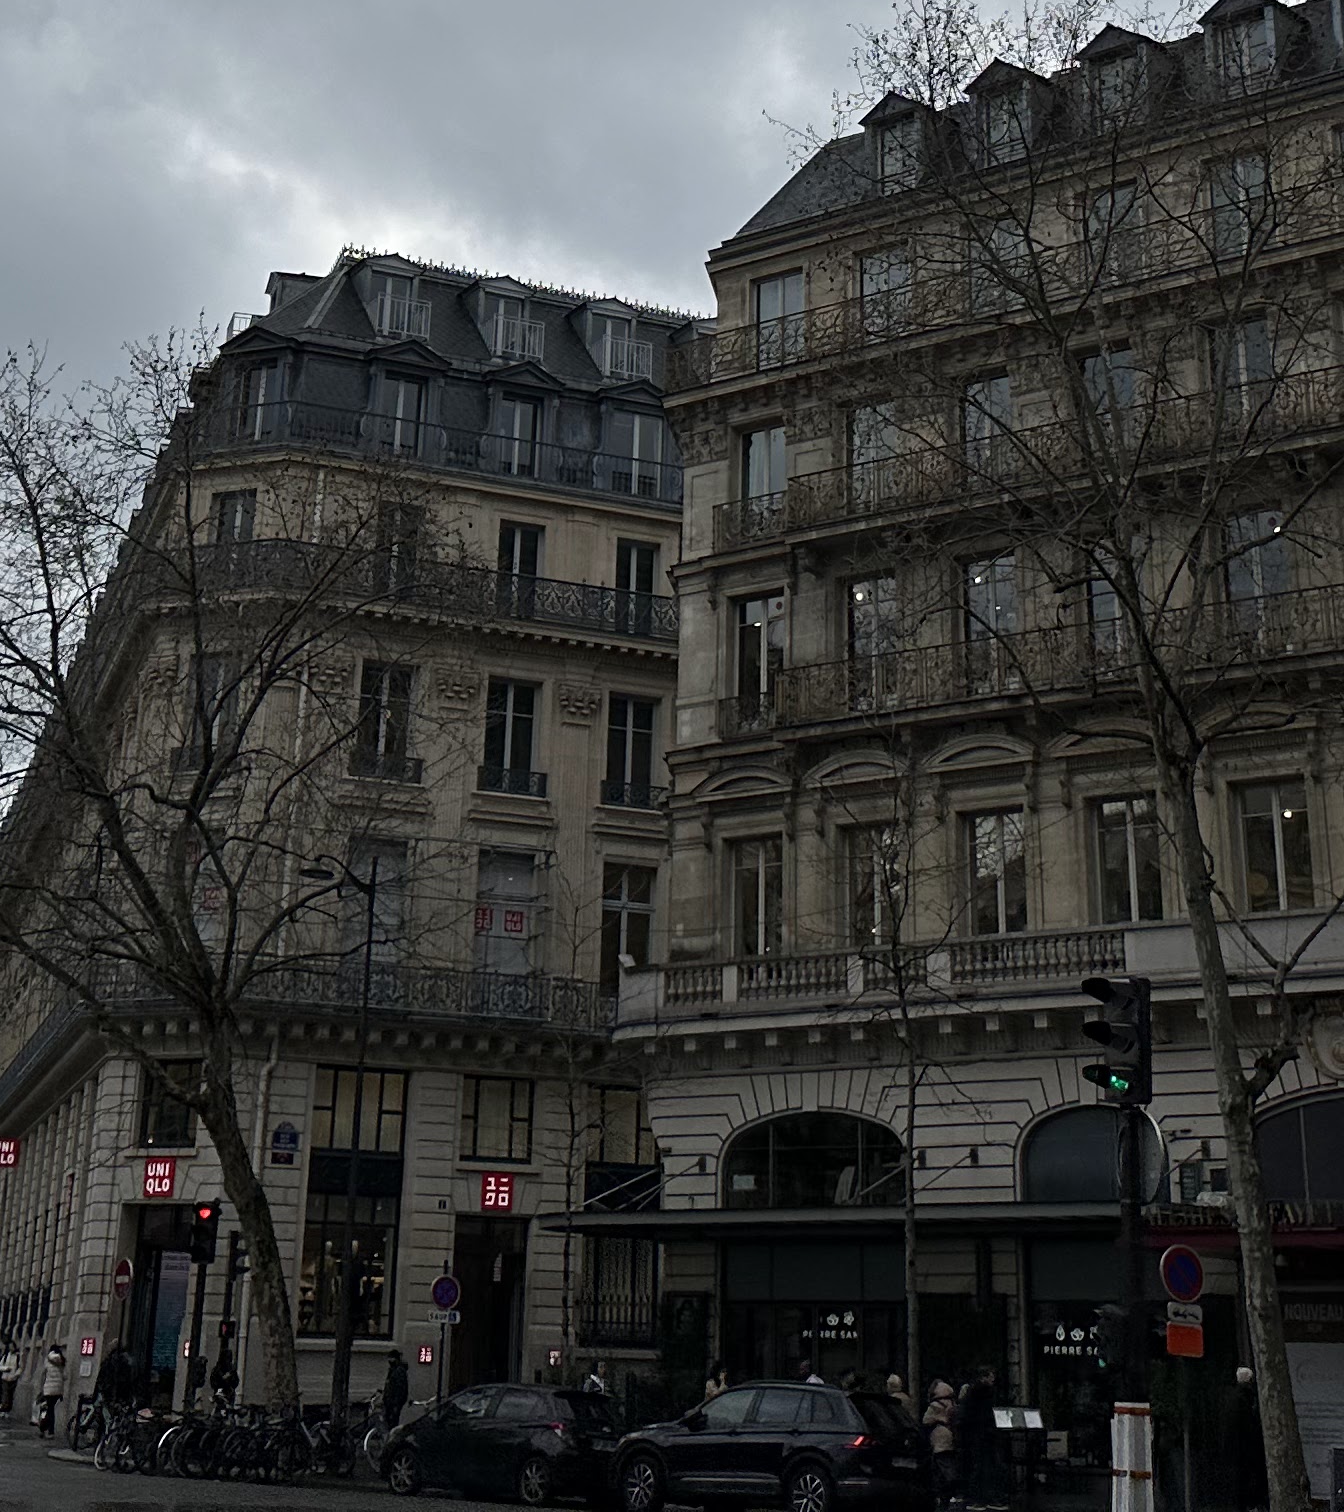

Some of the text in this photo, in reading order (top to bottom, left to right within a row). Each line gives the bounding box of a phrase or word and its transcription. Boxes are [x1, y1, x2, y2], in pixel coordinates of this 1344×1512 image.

[146, 1161, 170, 1177] UNI
[145, 1178, 170, 1195] QLO
[1283, 1302, 1344, 1321] NOUVEAU
[1043, 1345, 1083, 1355] PIERRE
